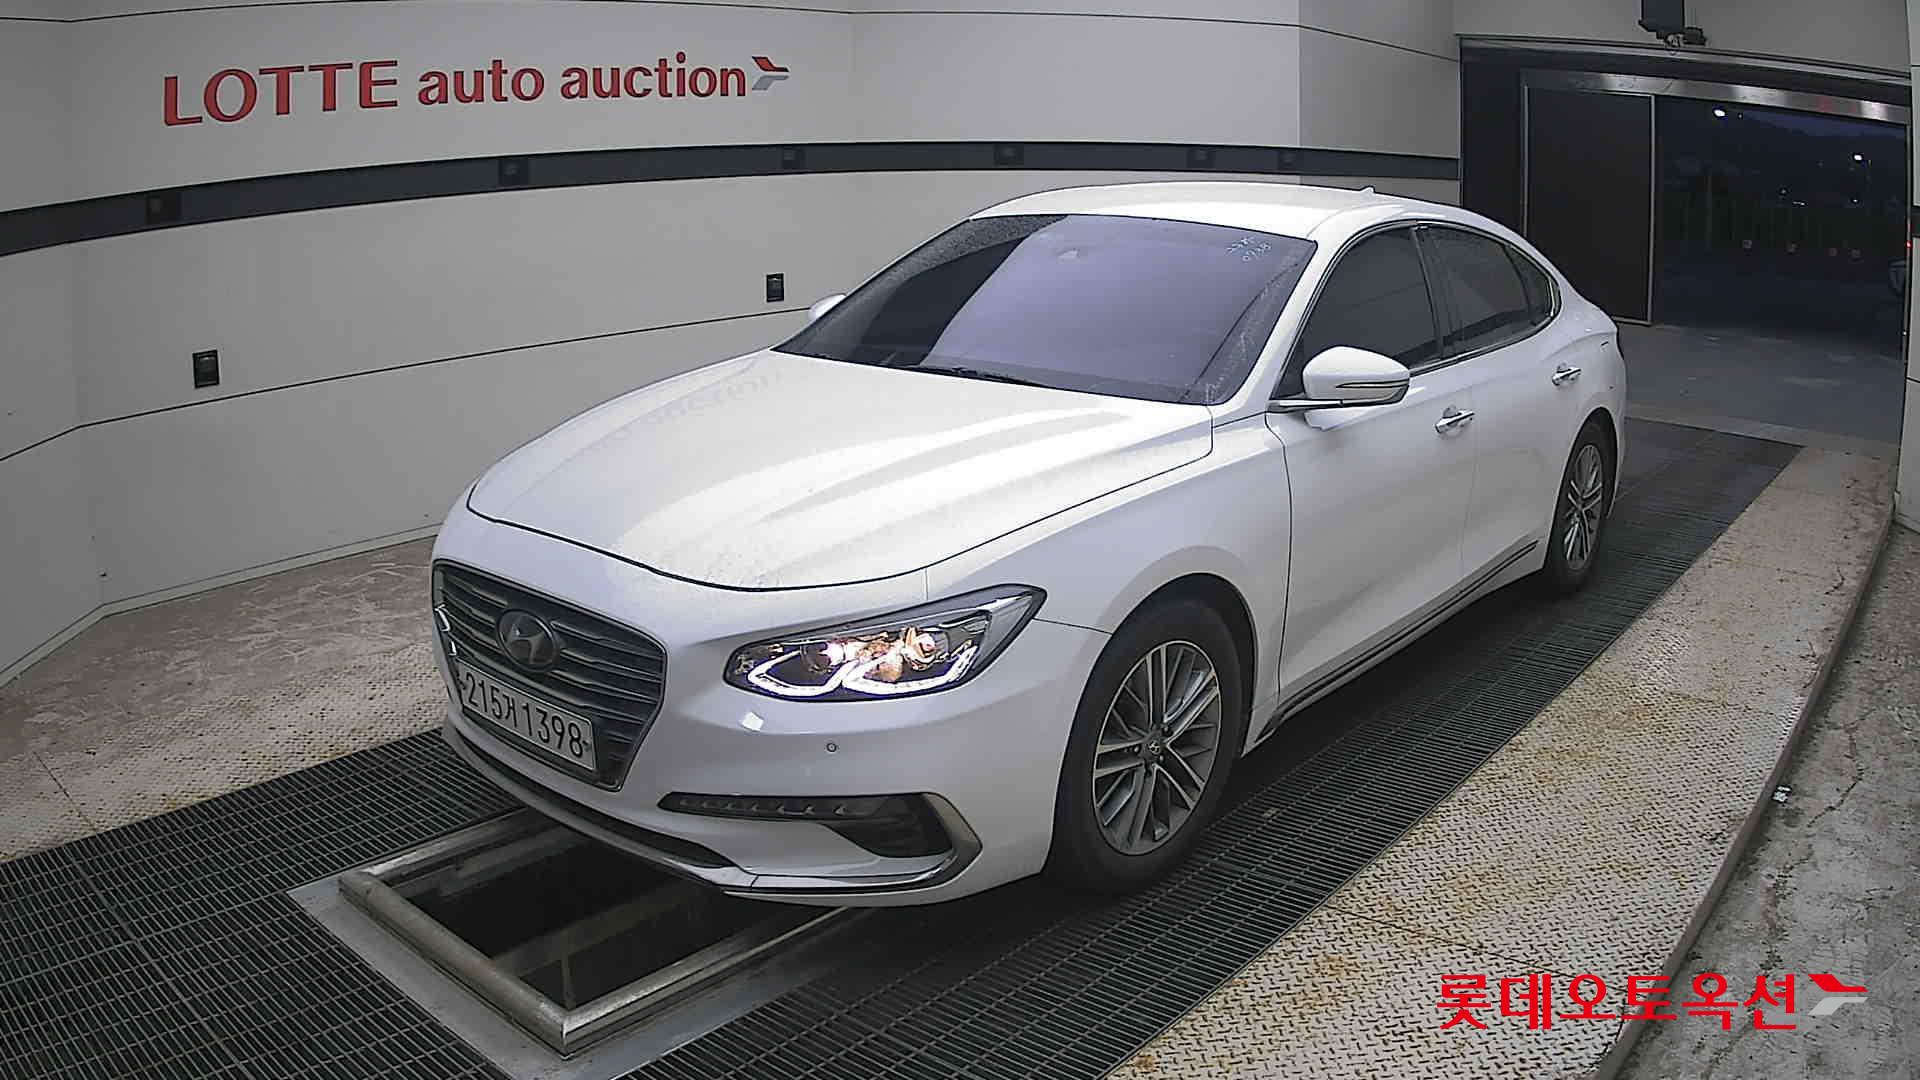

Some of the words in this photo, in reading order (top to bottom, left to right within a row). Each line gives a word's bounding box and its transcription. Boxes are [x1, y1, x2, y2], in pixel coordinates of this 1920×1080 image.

[163, 60, 399, 127] LOTTE
[417, 59, 545, 105] auto
[560, 51, 748, 99] auction
[466, 671, 584, 758] 215거1398
